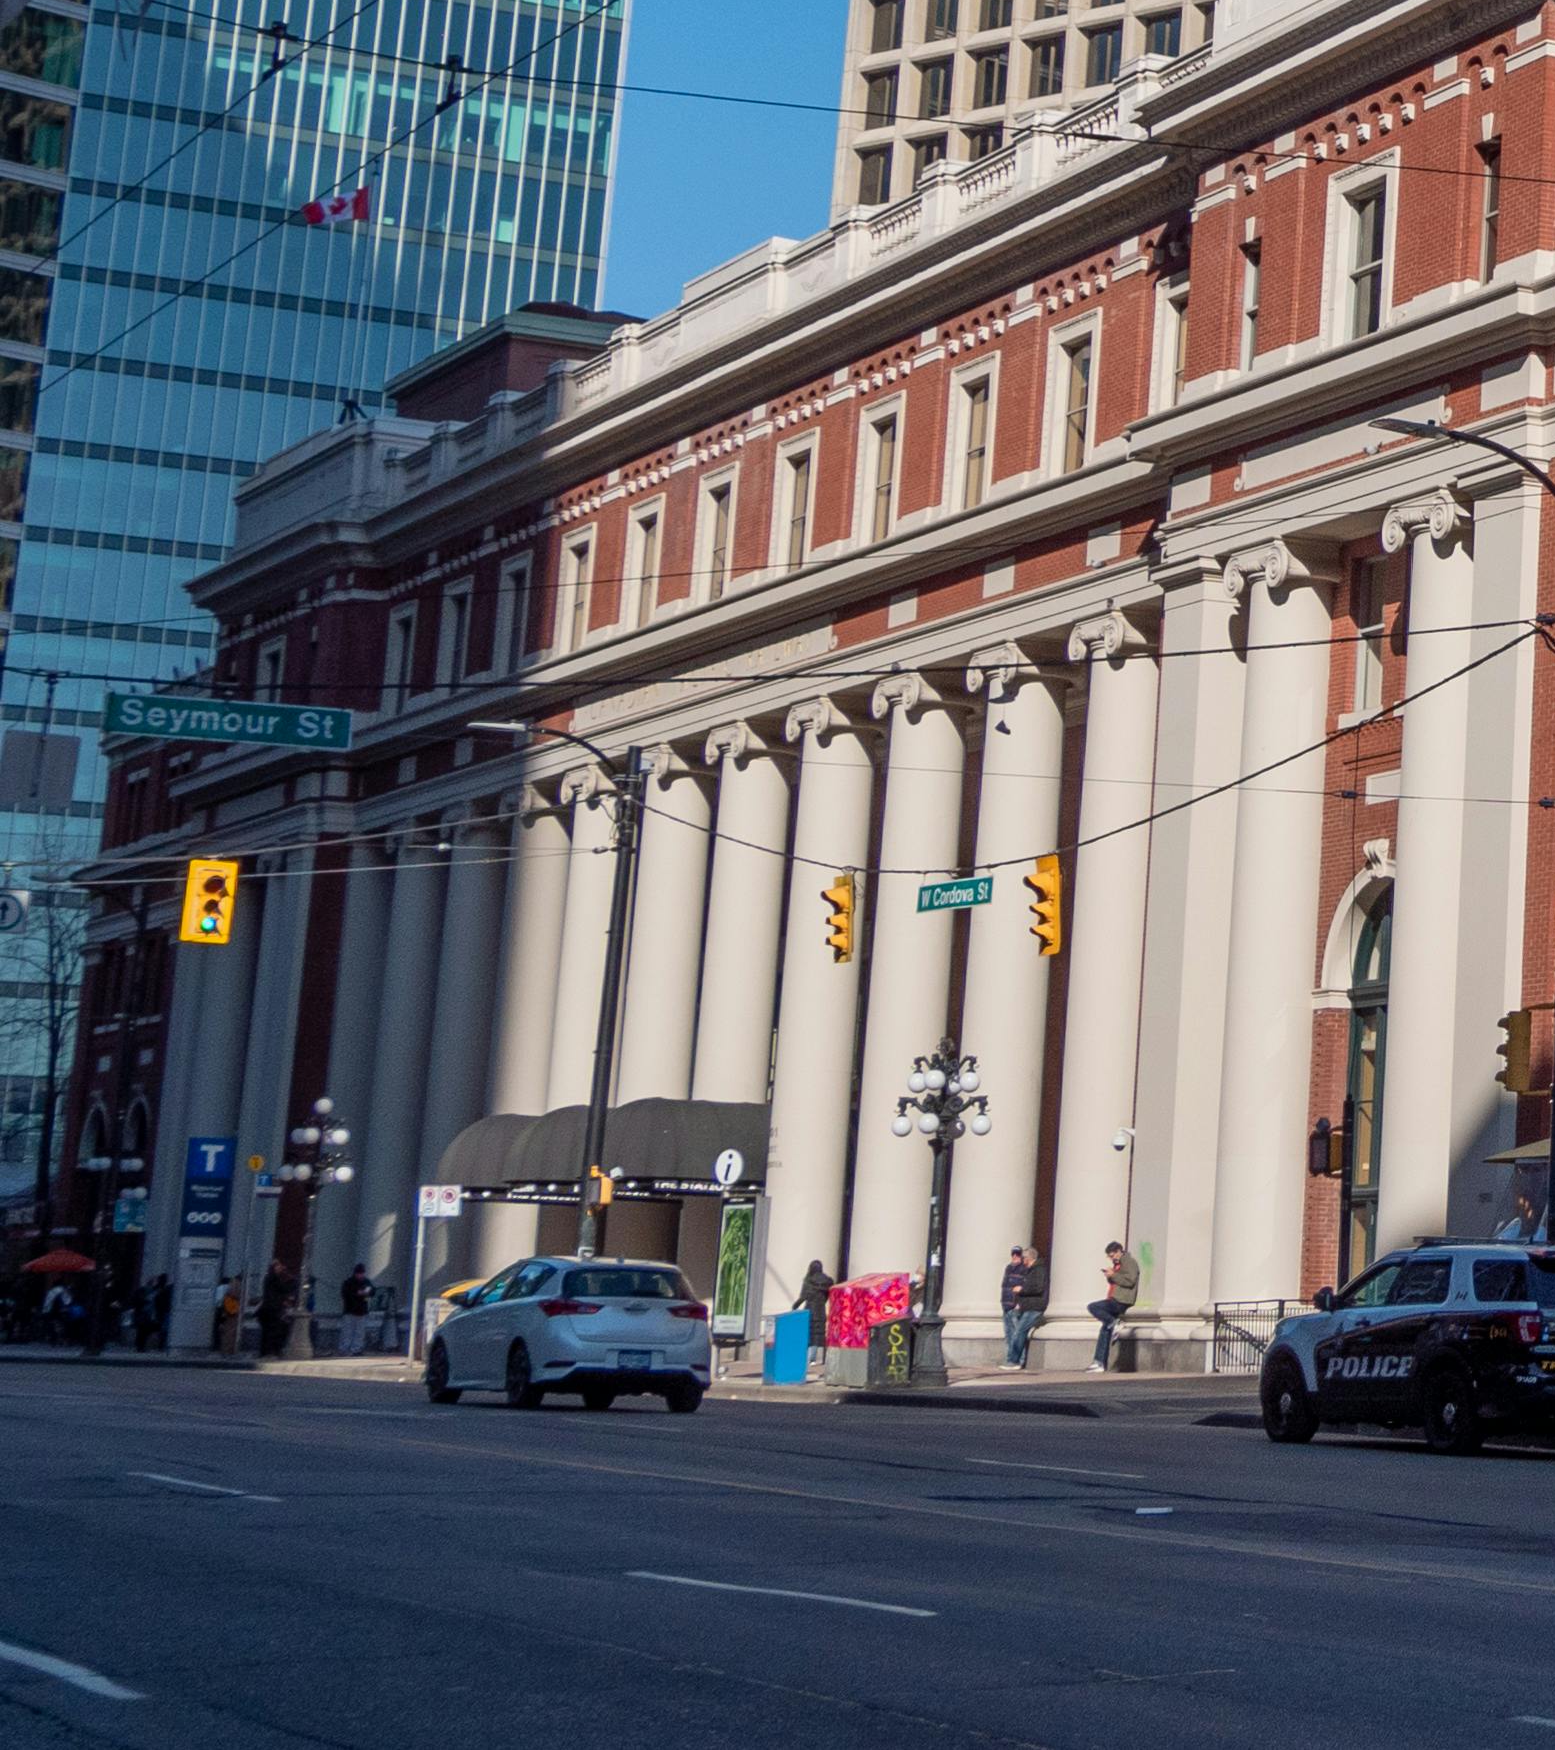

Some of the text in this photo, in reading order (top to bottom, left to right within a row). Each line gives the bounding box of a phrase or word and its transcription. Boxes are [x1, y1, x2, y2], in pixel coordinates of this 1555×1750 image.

[119, 699, 335, 739] Seymour St
[921, 882, 989, 908] W Cordova St
[200, 1144, 226, 1172] T
[1325, 1355, 1413, 1379] POLICE
